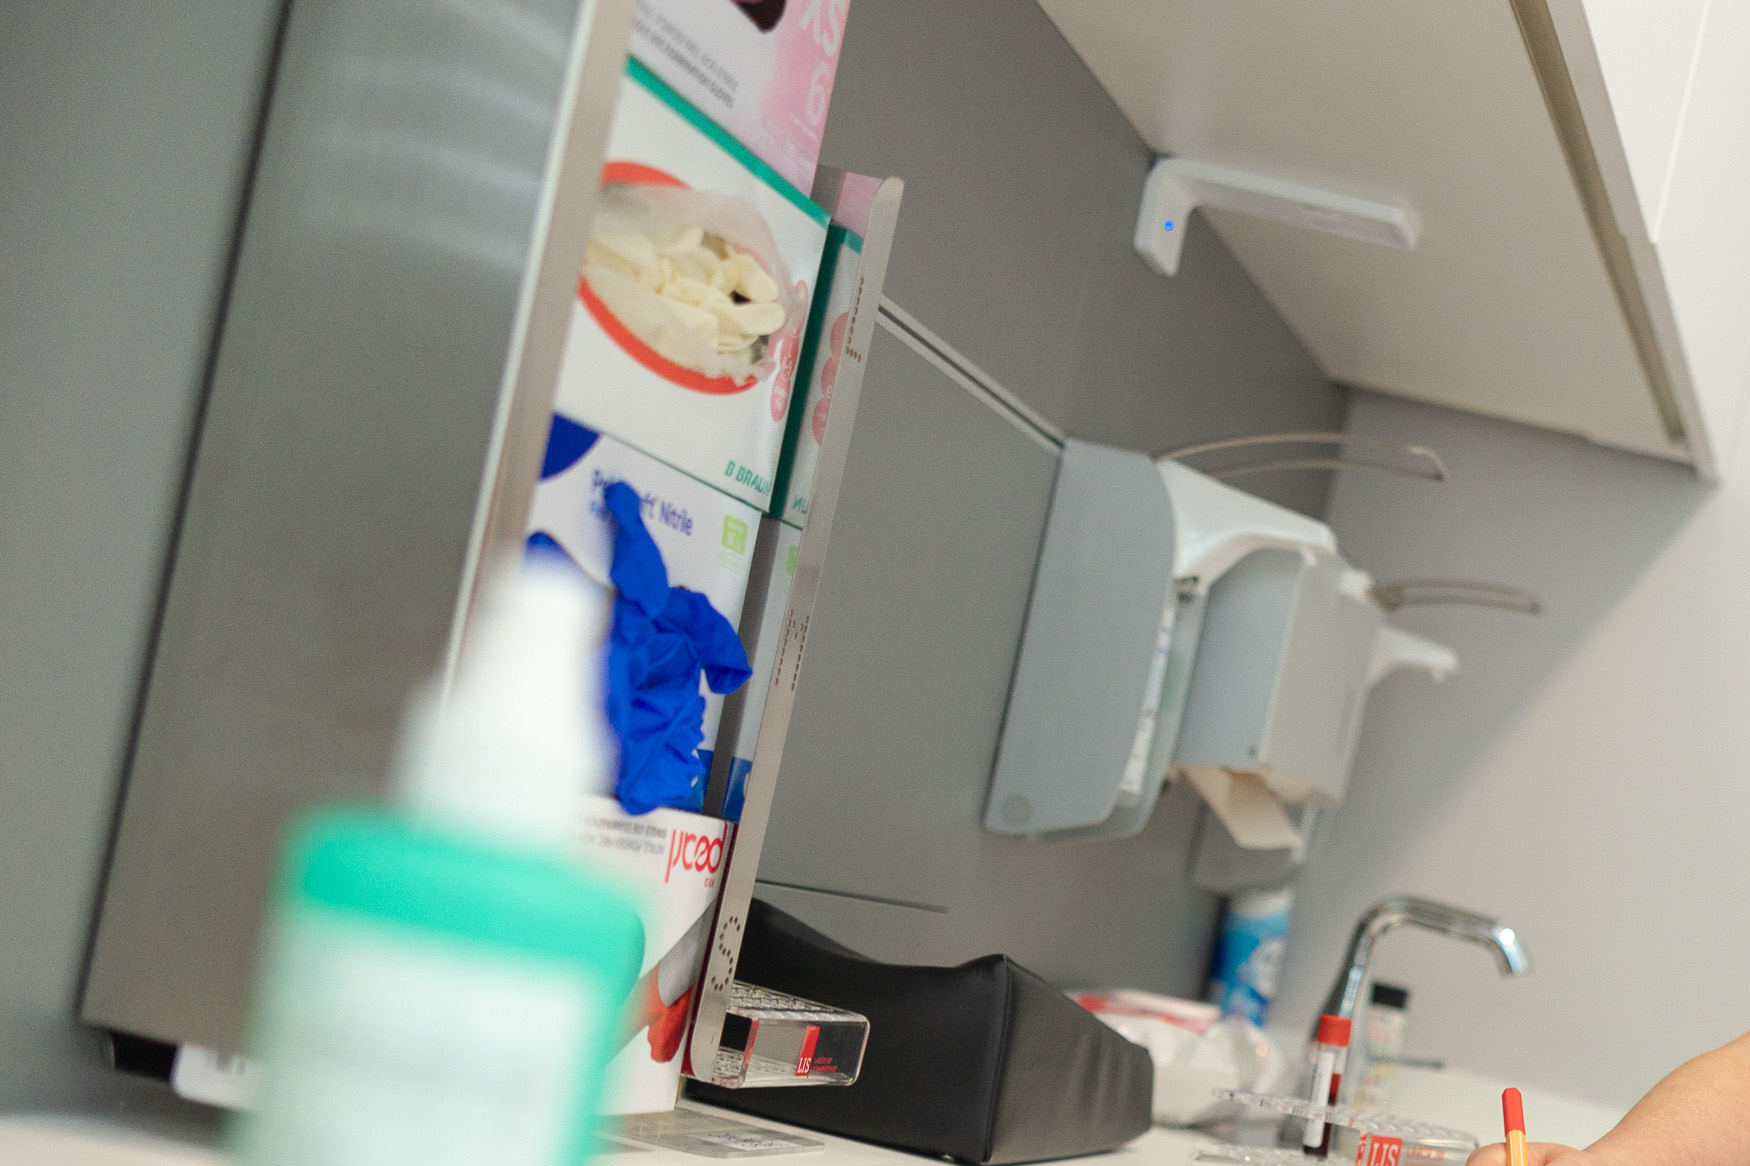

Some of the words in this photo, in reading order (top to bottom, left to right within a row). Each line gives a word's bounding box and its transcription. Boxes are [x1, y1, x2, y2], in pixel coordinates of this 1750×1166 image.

[806, 60, 831, 126] 6
[660, 499, 693, 536] Nitrile
[664, 821, 729, 884] pearl
[797, 1056, 812, 1074] LIS
